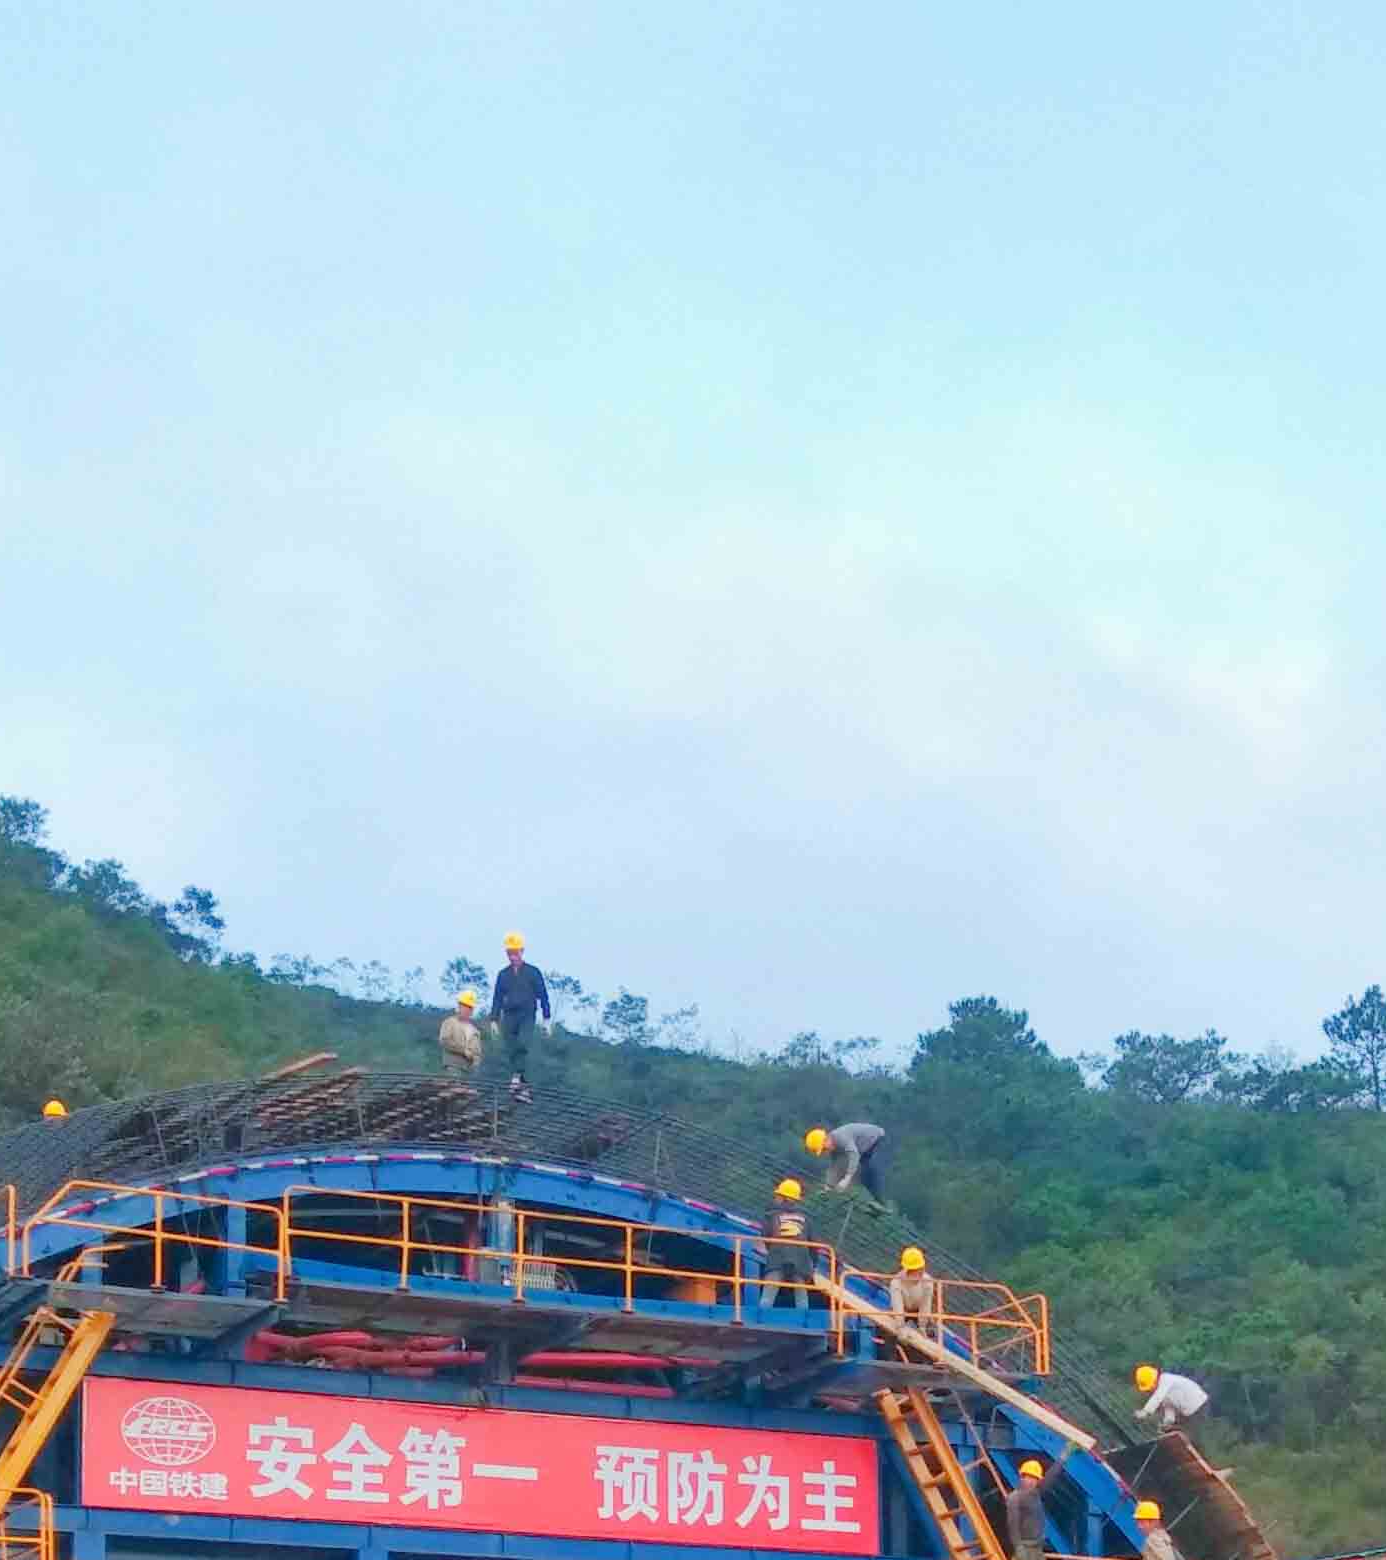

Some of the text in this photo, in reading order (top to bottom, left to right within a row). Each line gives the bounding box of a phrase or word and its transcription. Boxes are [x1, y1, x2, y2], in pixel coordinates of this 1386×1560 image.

[110, 1467, 229, 1500] 中国铁建
[246, 1416, 860, 1533] 安全第一 预防为主
